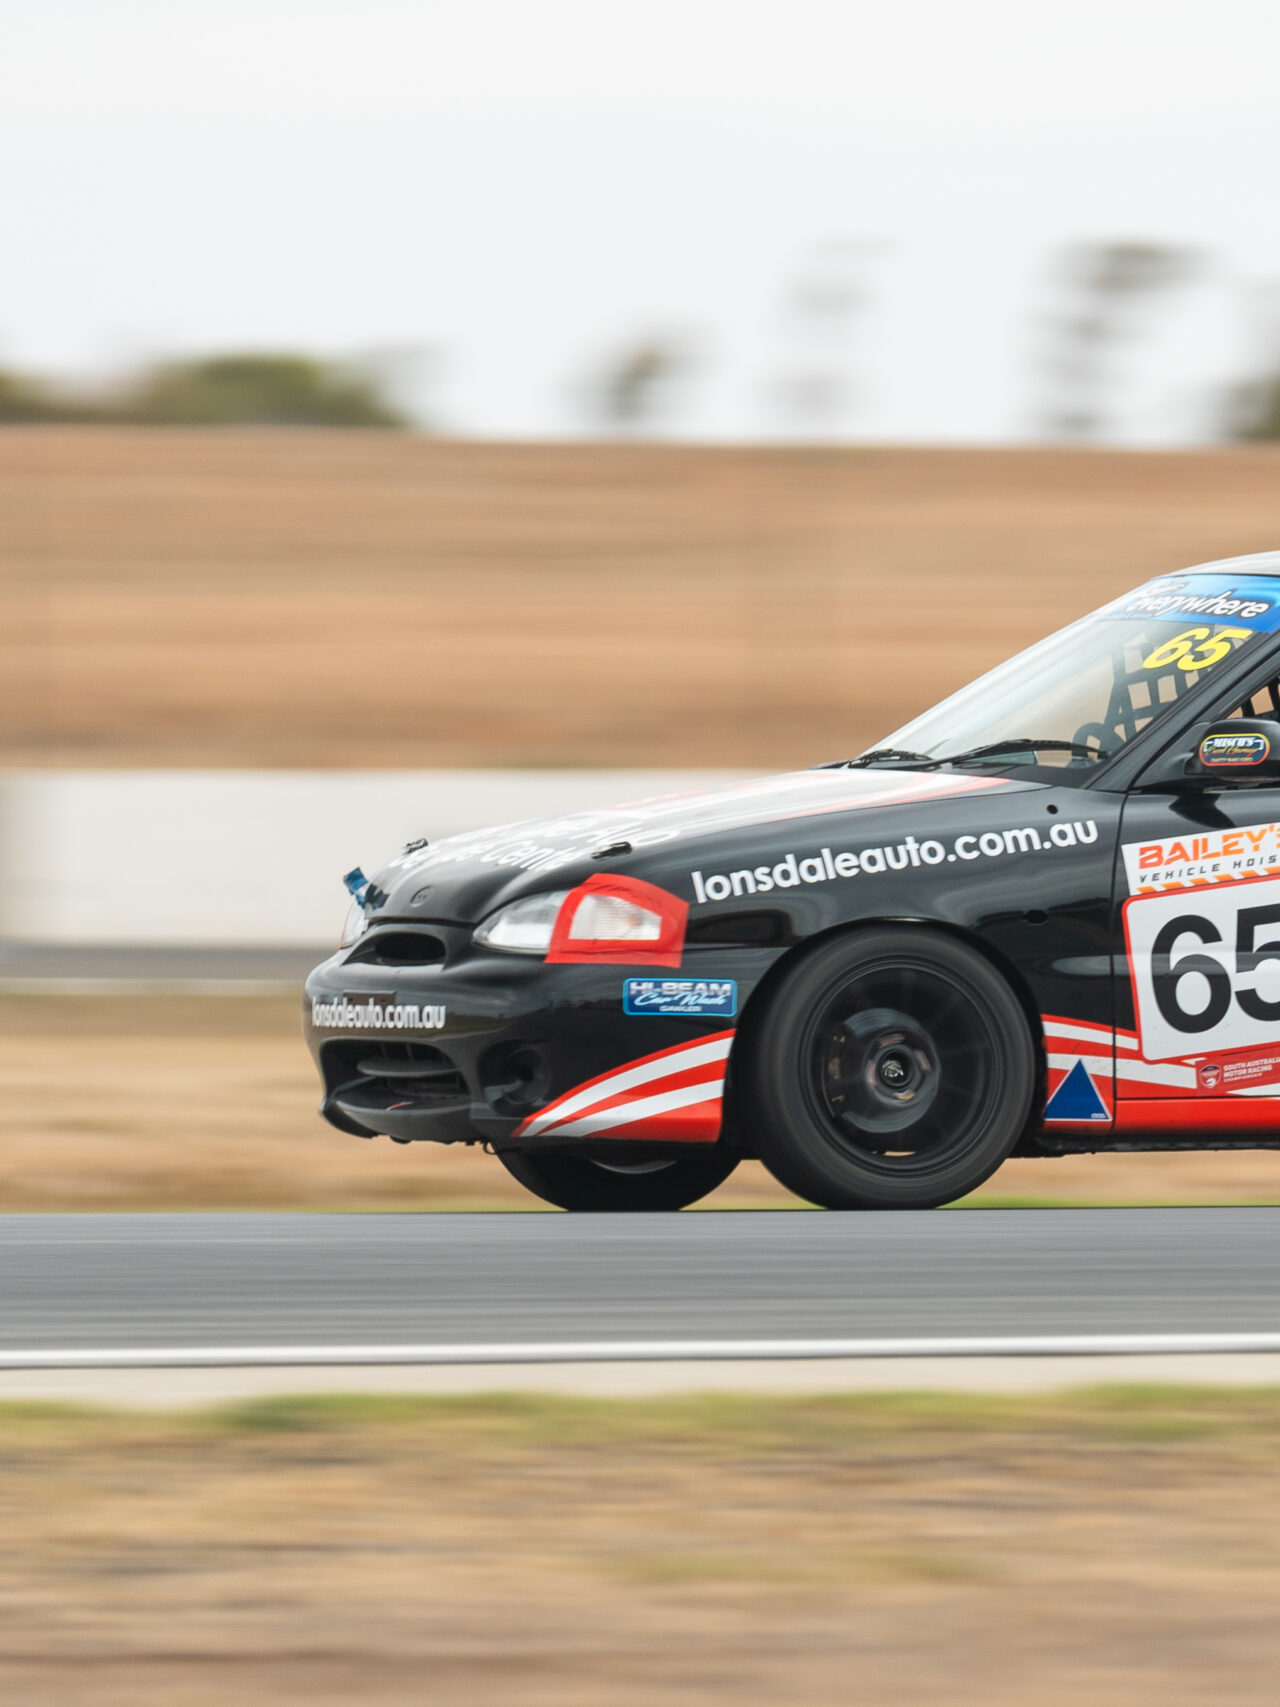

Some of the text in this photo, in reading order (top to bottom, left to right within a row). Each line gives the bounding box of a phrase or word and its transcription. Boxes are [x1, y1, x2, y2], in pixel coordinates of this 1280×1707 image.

[1143, 627, 1254, 671] 65
[691, 820, 1099, 903] lonsdaleauto.com.au
[1139, 863, 1221, 884] VEHICLE
[629, 981, 733, 996] HI-BEAM
[311, 996, 447, 1029] lonsdaleauto.com.au
